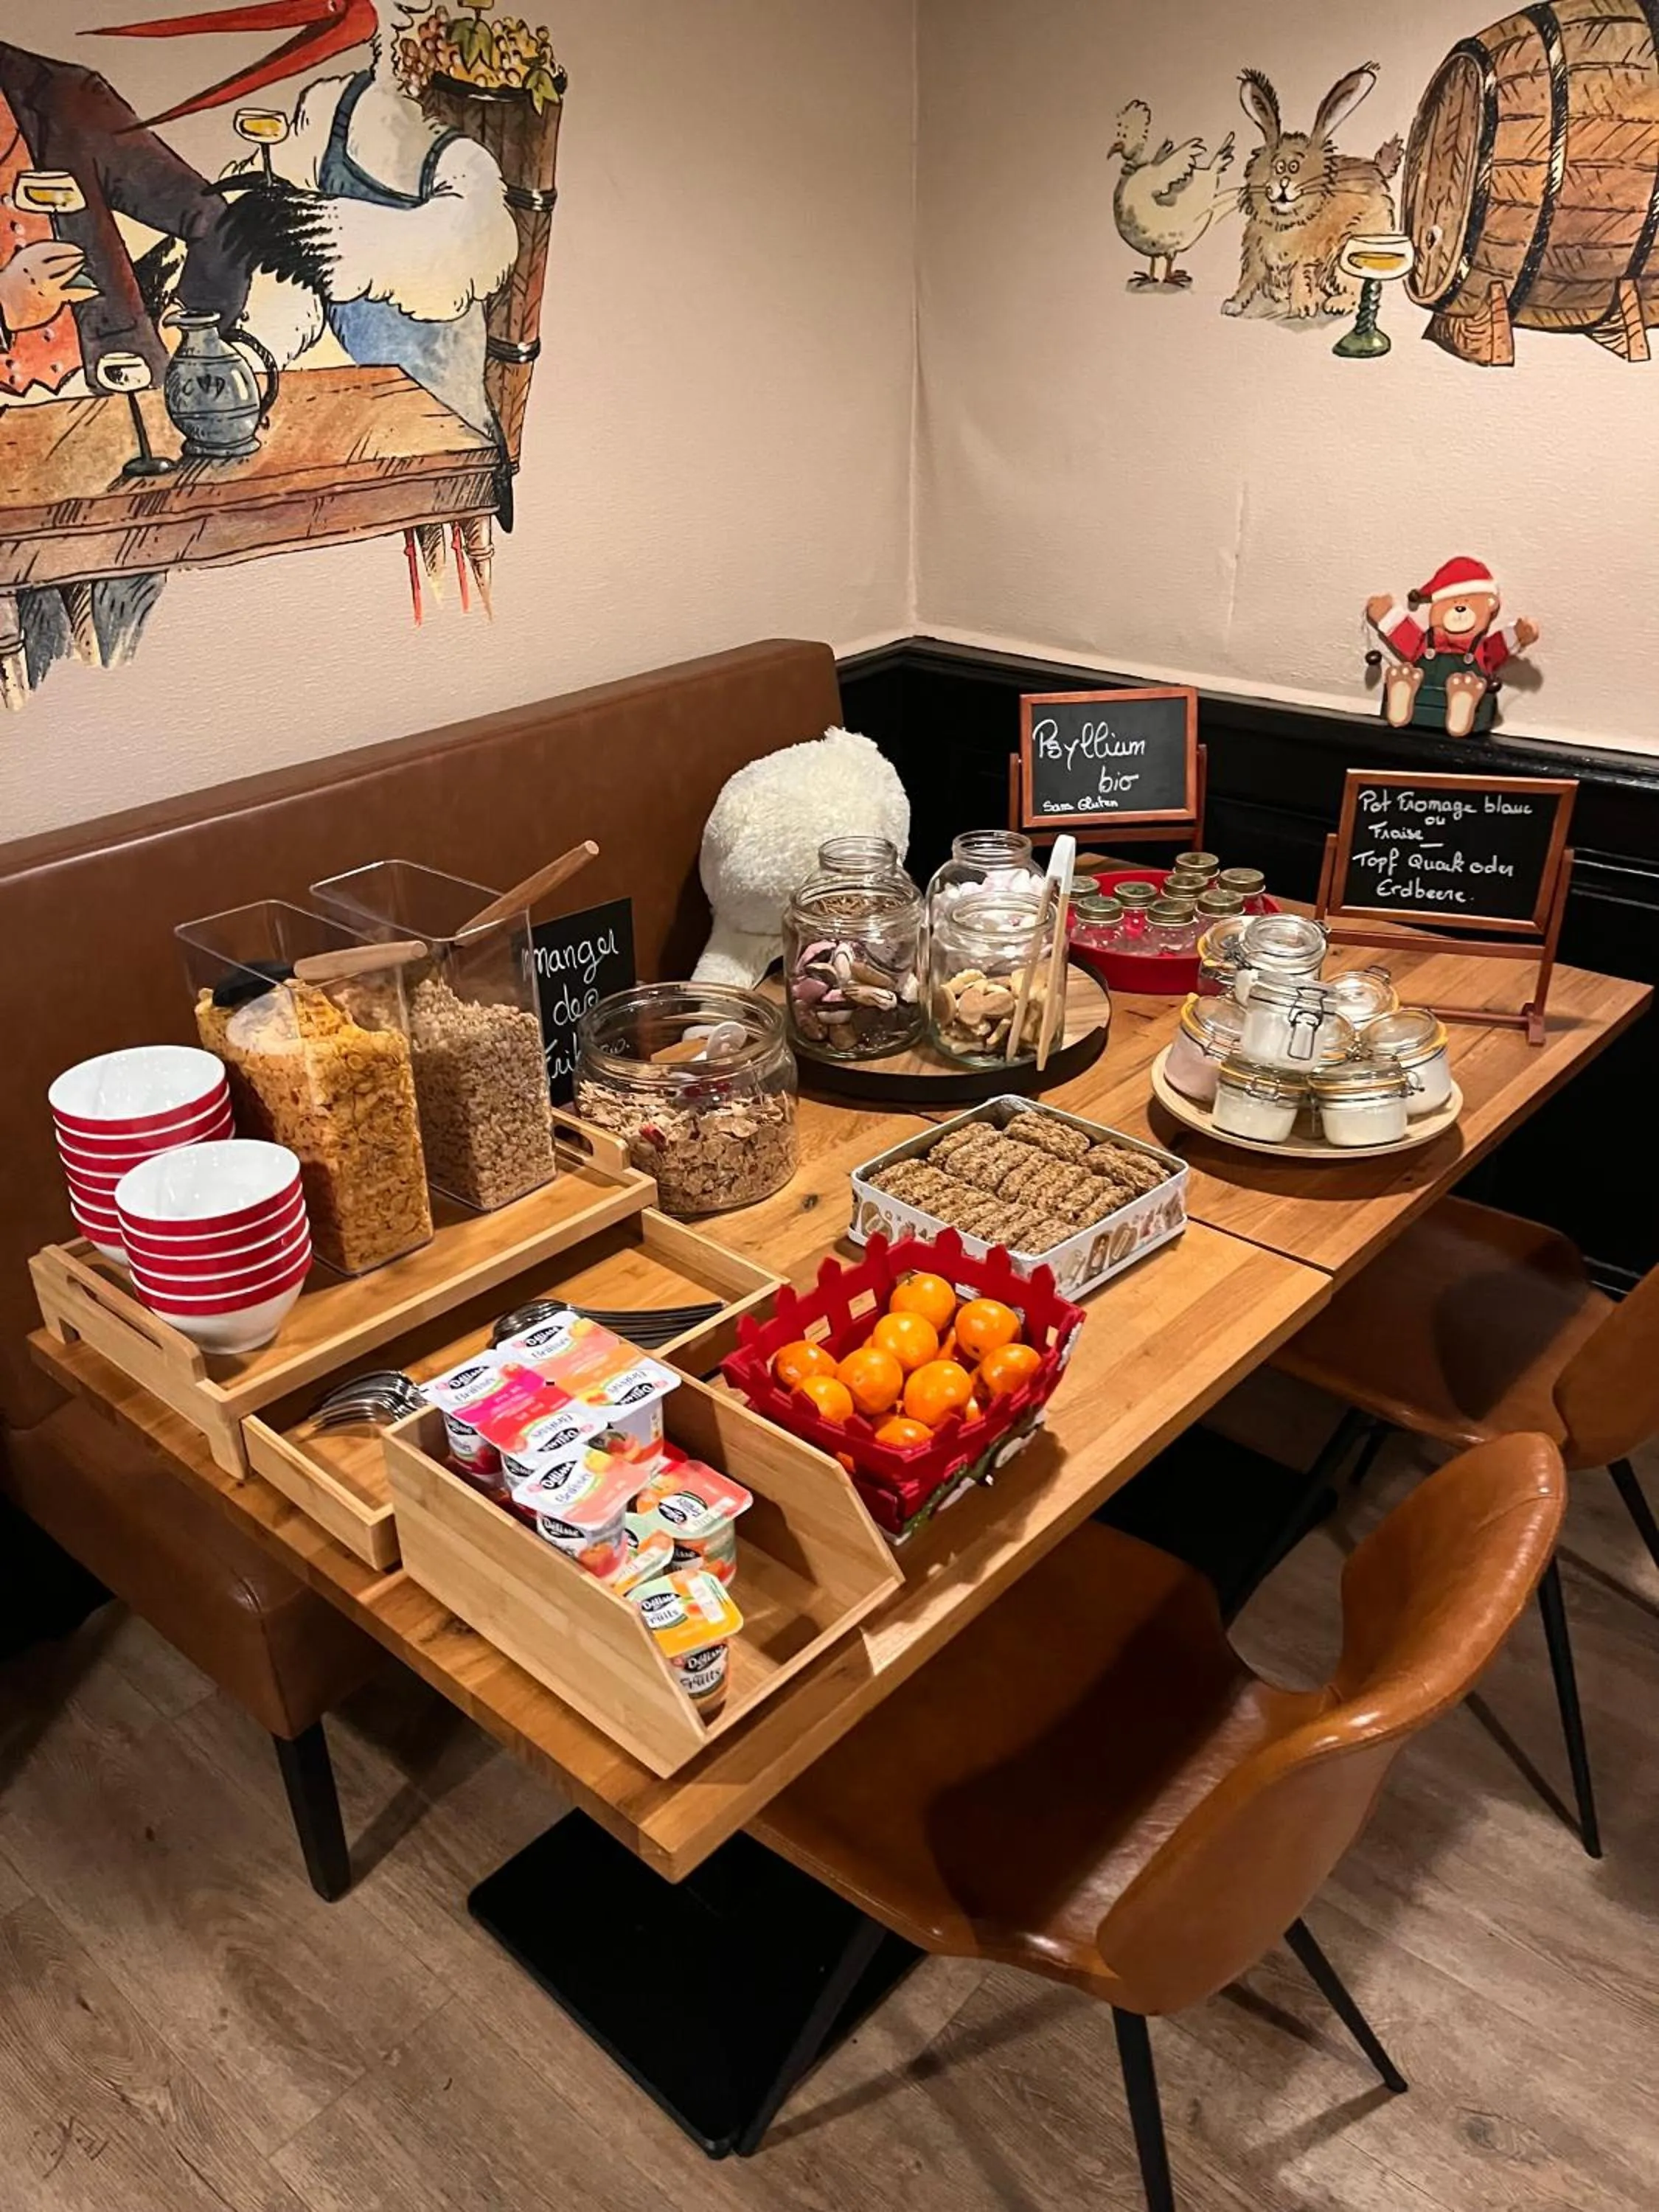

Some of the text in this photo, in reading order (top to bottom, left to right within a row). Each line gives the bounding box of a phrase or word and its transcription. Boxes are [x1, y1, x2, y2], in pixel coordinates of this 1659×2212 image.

[1033, 719, 1146, 771] Psyllium
[1098, 765, 1139, 793] bio
[1358, 789, 1392, 813] Pot
[1397, 791, 1477, 821] Fromage
[1368, 821, 1424, 841] Fraise
[1424, 815, 1446, 826] ou
[1352, 847, 1514, 877] Topf Quark oder
